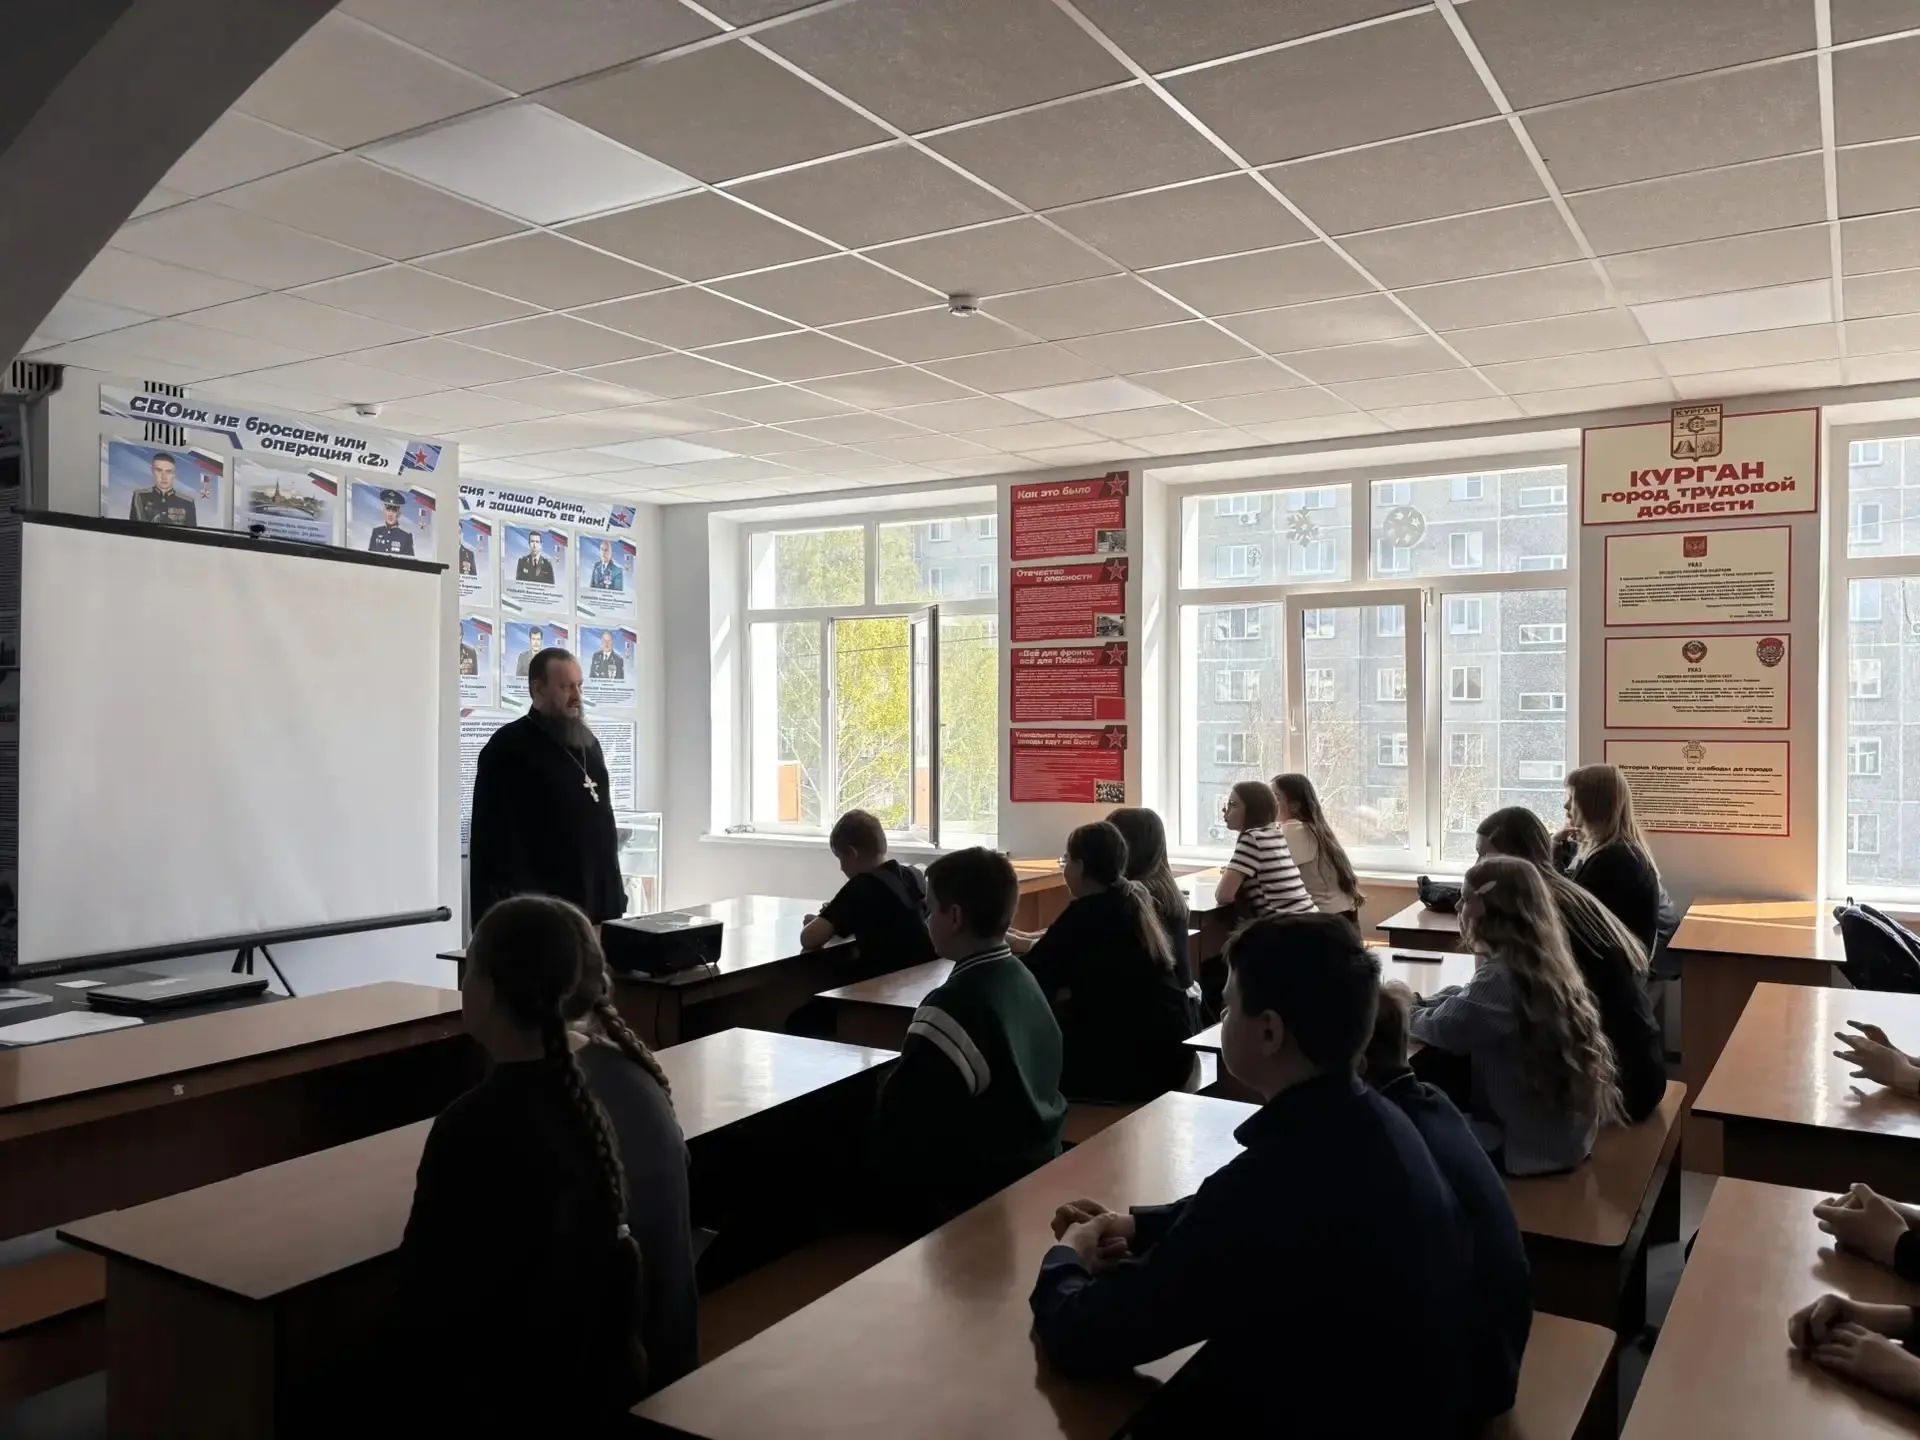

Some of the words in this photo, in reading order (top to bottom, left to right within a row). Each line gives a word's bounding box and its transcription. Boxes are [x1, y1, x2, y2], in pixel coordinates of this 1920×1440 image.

[1675, 407, 1718, 417] КУРГАН
[213, 414, 240, 428] не
[245, 416, 330, 445] бросаем
[334, 435, 367, 451] или
[260, 437, 352, 463] операция
[357, 453, 389, 468] «Z»
[1630, 461, 1764, 488] КУРГАН
[459, 484, 485, 497] сия
[499, 490, 534, 505] наша
[537, 495, 586, 515] Родина,
[1017, 490, 1038, 500] Как
[1040, 488, 1060, 498] это
[1062, 485, 1092, 496] было
[1601, 489, 1670, 506] город
[1677, 476, 1796, 501] трудовой
[476, 499, 485, 508] и
[488, 500, 557, 519] защищать
[578, 516, 605, 528] нам!
[1637, 499, 1754, 519] доблести
[1016, 568, 1065, 578] Отечество
[1044, 574, 1093, 583] опасности
